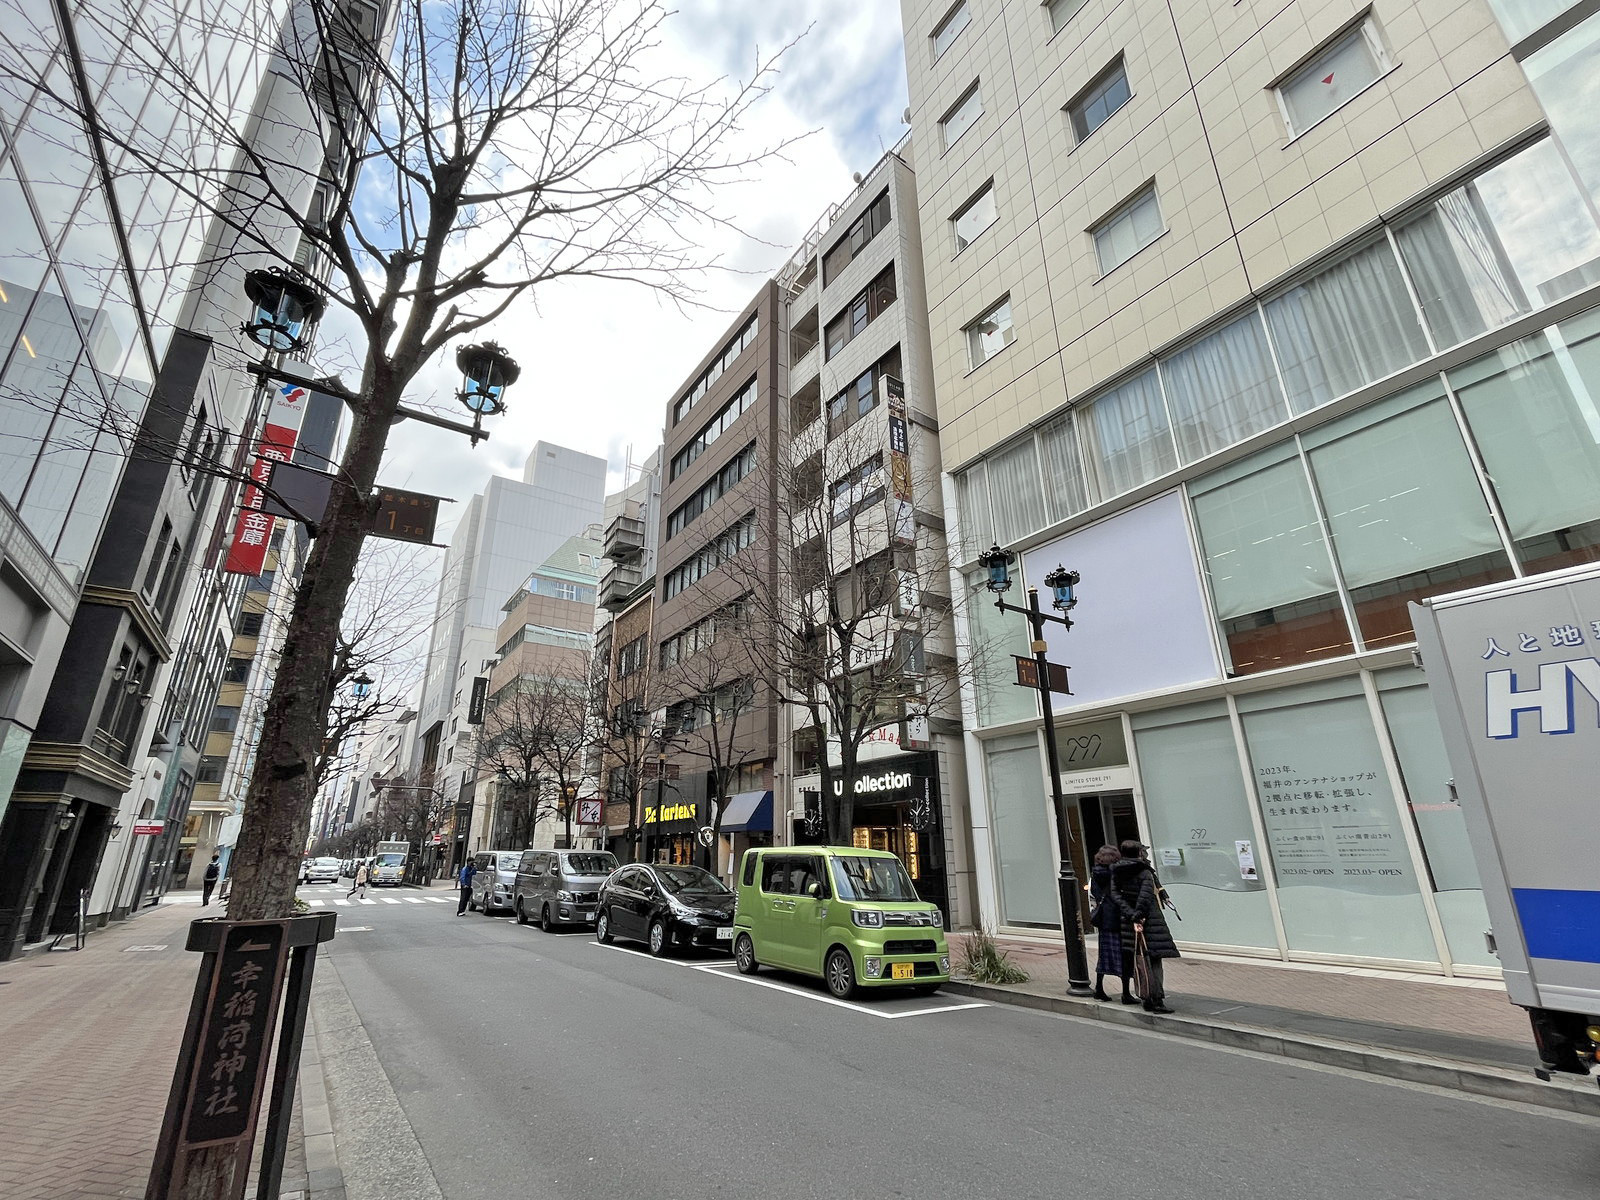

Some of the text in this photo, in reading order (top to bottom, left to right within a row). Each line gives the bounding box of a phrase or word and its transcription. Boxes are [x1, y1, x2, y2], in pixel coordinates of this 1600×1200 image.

[276, 400, 302, 411] SAIKYO
[1260, 765, 1297, 776] 2023年、
[833, 771, 912, 796] Uollection
[1262, 772, 1377, 789] 福井のアンテナショップが
[1268, 803, 1358, 817] 生まれ変わります。
[203, 960, 263, 1117] 幸稲荷神社
